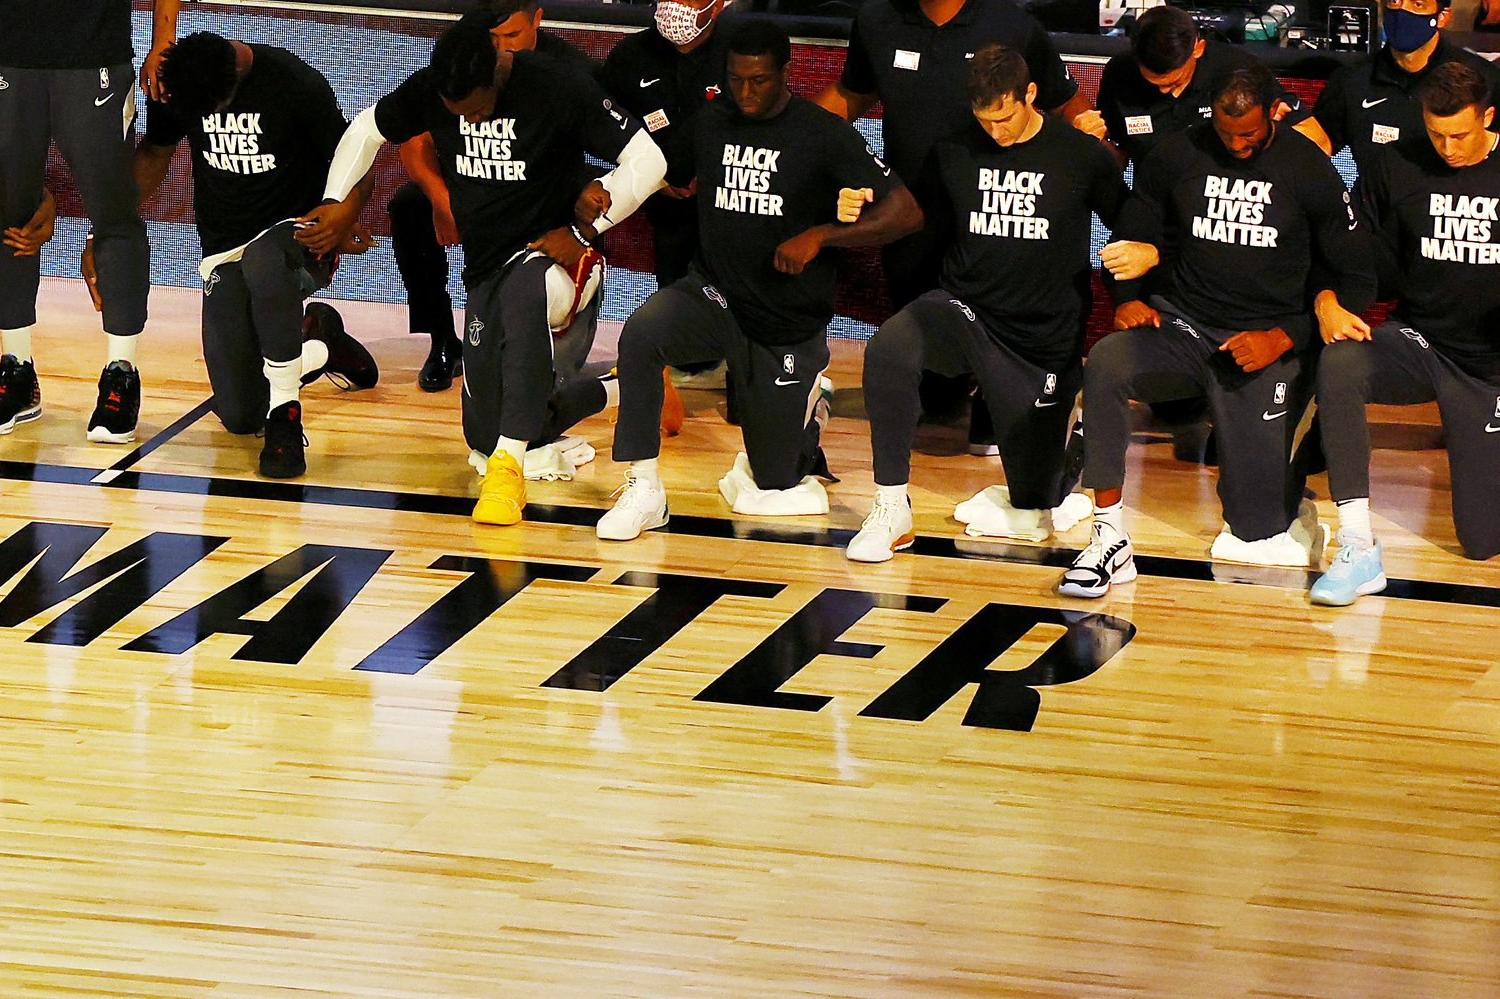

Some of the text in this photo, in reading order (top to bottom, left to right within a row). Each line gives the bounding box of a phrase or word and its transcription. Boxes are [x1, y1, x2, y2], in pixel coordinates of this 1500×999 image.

[202, 112, 263, 134] BLACK
[460, 114, 517, 140] BLACK
[209, 133, 259, 155] LIVES
[464, 136, 512, 160] LIVES
[202, 150, 277, 175] MATTER
[456, 154, 527, 181] MATTER
[722, 144, 781, 172] BLACK
[724, 166, 771, 193] LIVES
[978, 168, 1045, 195] BLACK
[1204, 175, 1273, 204] BLACK
[714, 186, 784, 216] MATTER
[982, 191, 1036, 216] LIVES
[1207, 198, 1265, 225] LIVES
[1429, 193, 1500, 221] BLACK
[969, 211, 1049, 240] MATTER
[1192, 216, 1278, 248] MATTER
[1434, 217, 1491, 242] LIVES
[1421, 236, 1500, 264] MATTER
